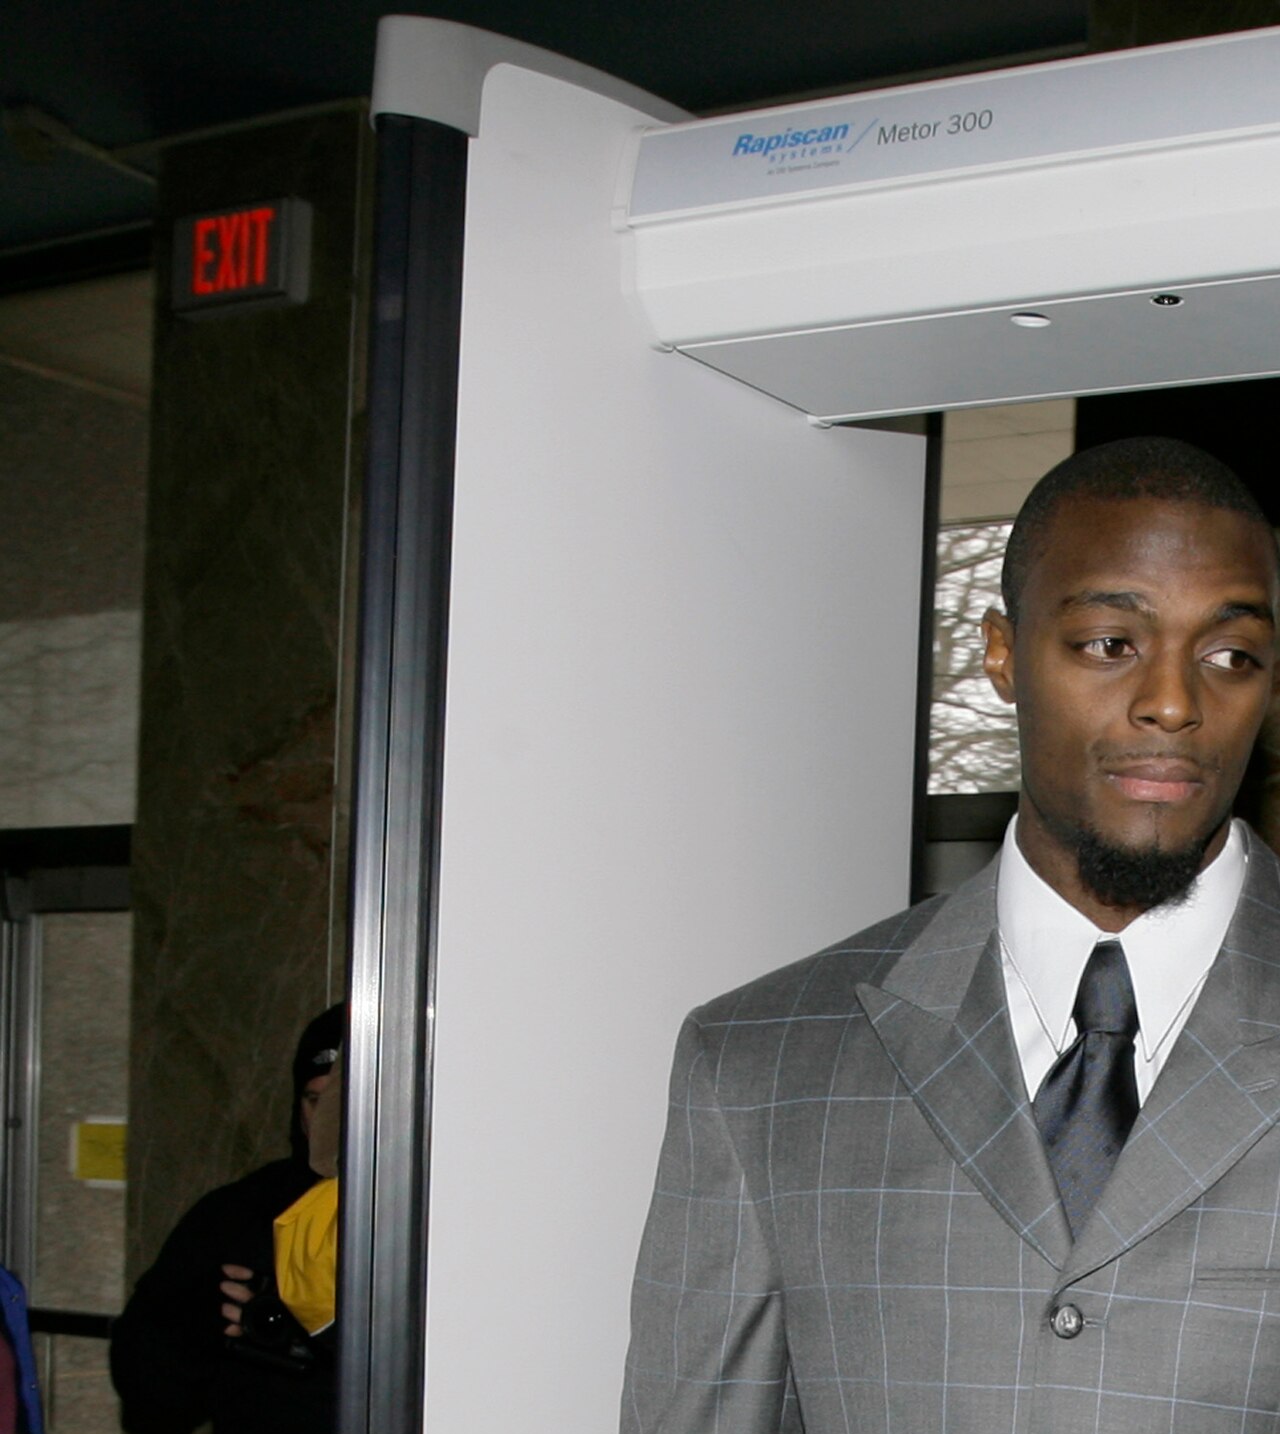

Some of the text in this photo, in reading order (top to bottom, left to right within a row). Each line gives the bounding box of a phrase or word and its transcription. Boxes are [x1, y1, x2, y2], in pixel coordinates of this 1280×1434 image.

[732, 123, 849, 157] Rapiscan
[877, 109, 993, 146] Metor 300
[769, 144, 843, 164] systems
[192, 207, 274, 296] EXIT
